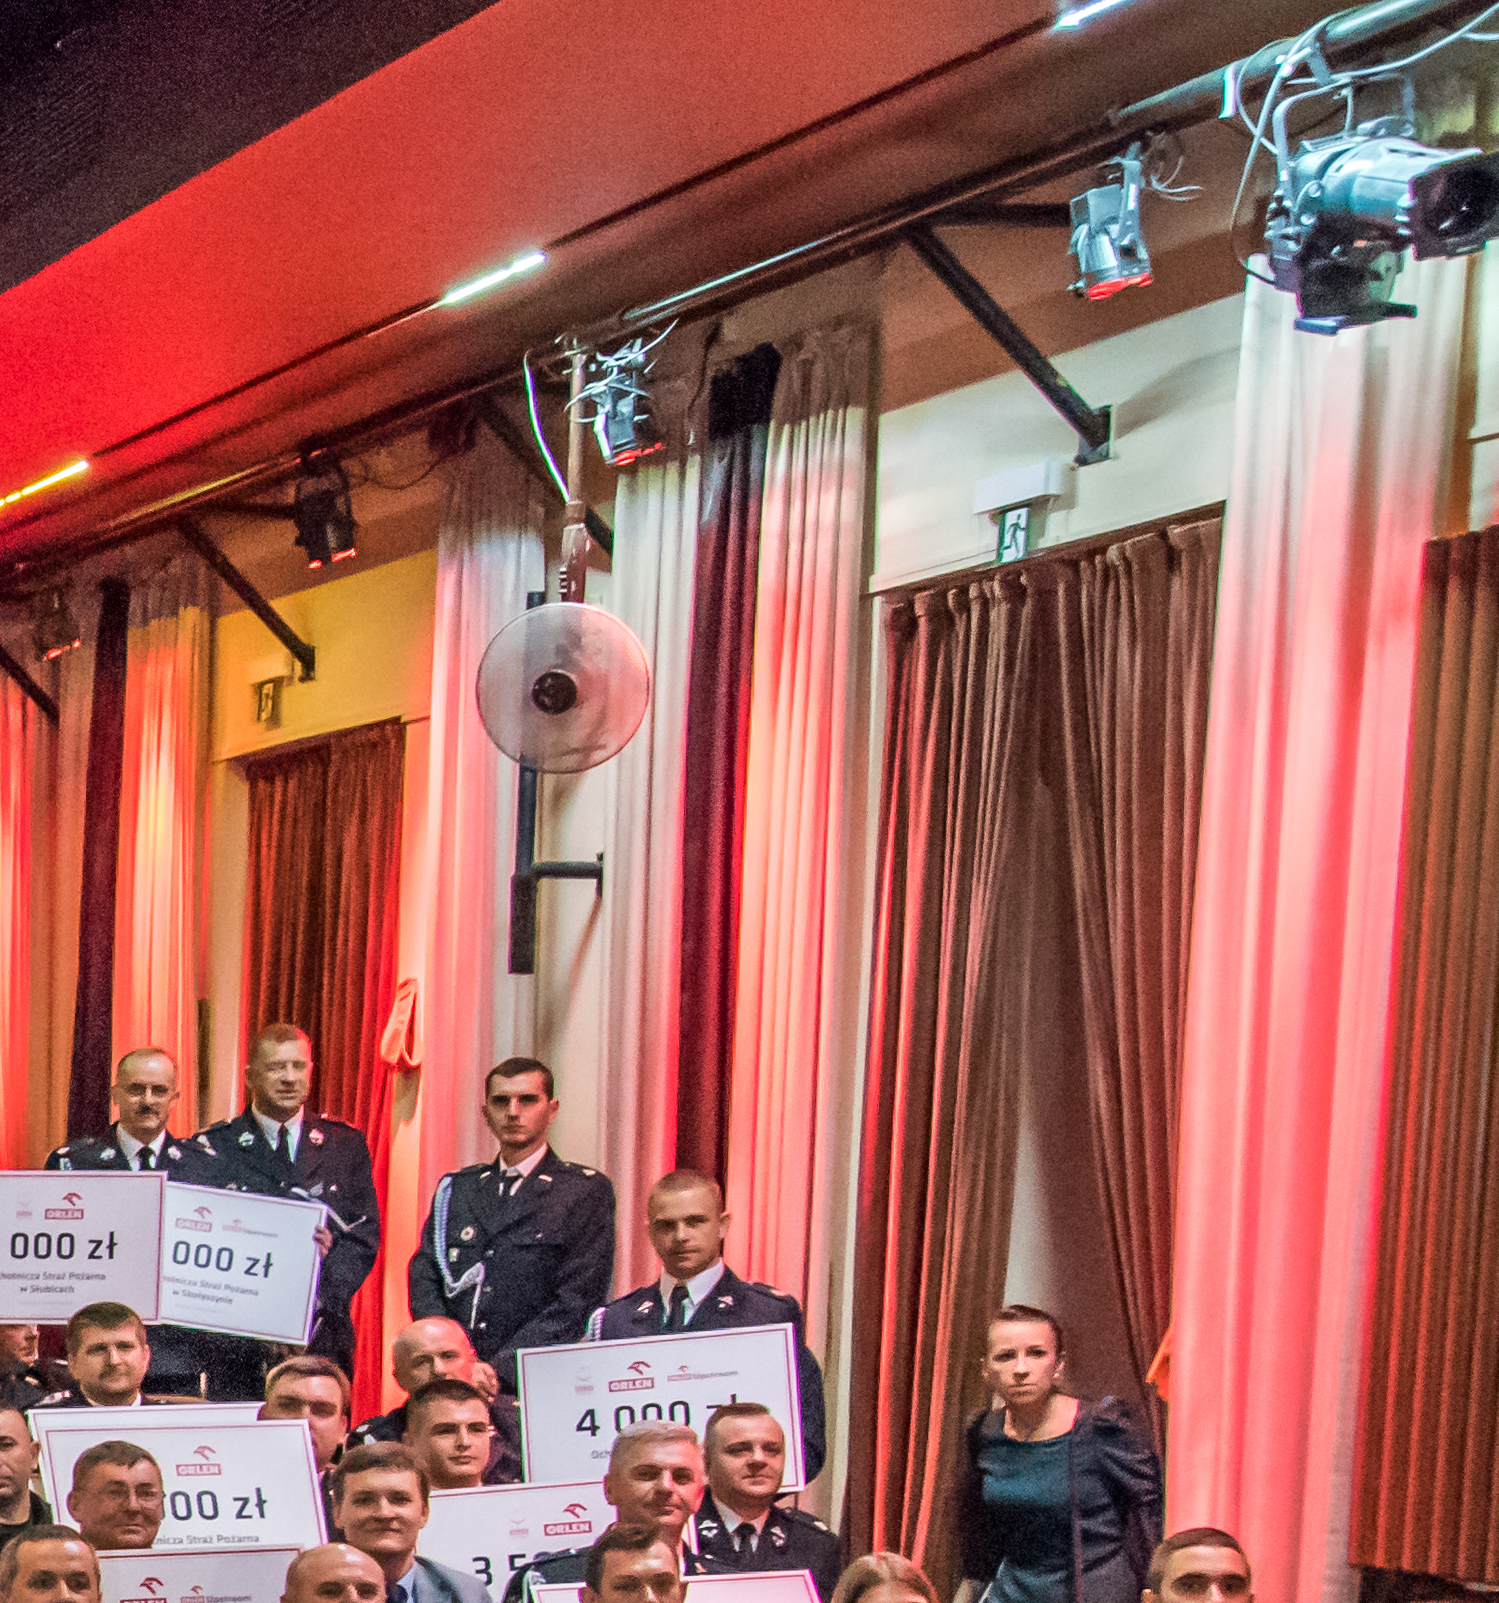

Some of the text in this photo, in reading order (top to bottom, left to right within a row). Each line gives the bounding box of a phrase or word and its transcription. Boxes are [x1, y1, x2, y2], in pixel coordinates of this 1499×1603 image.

[11, 1233, 74, 1259] 000
[88, 1231, 117, 1259] zł
[609, 1378, 653, 1390] ORLEN
[576, 1409, 600, 1436] 4
